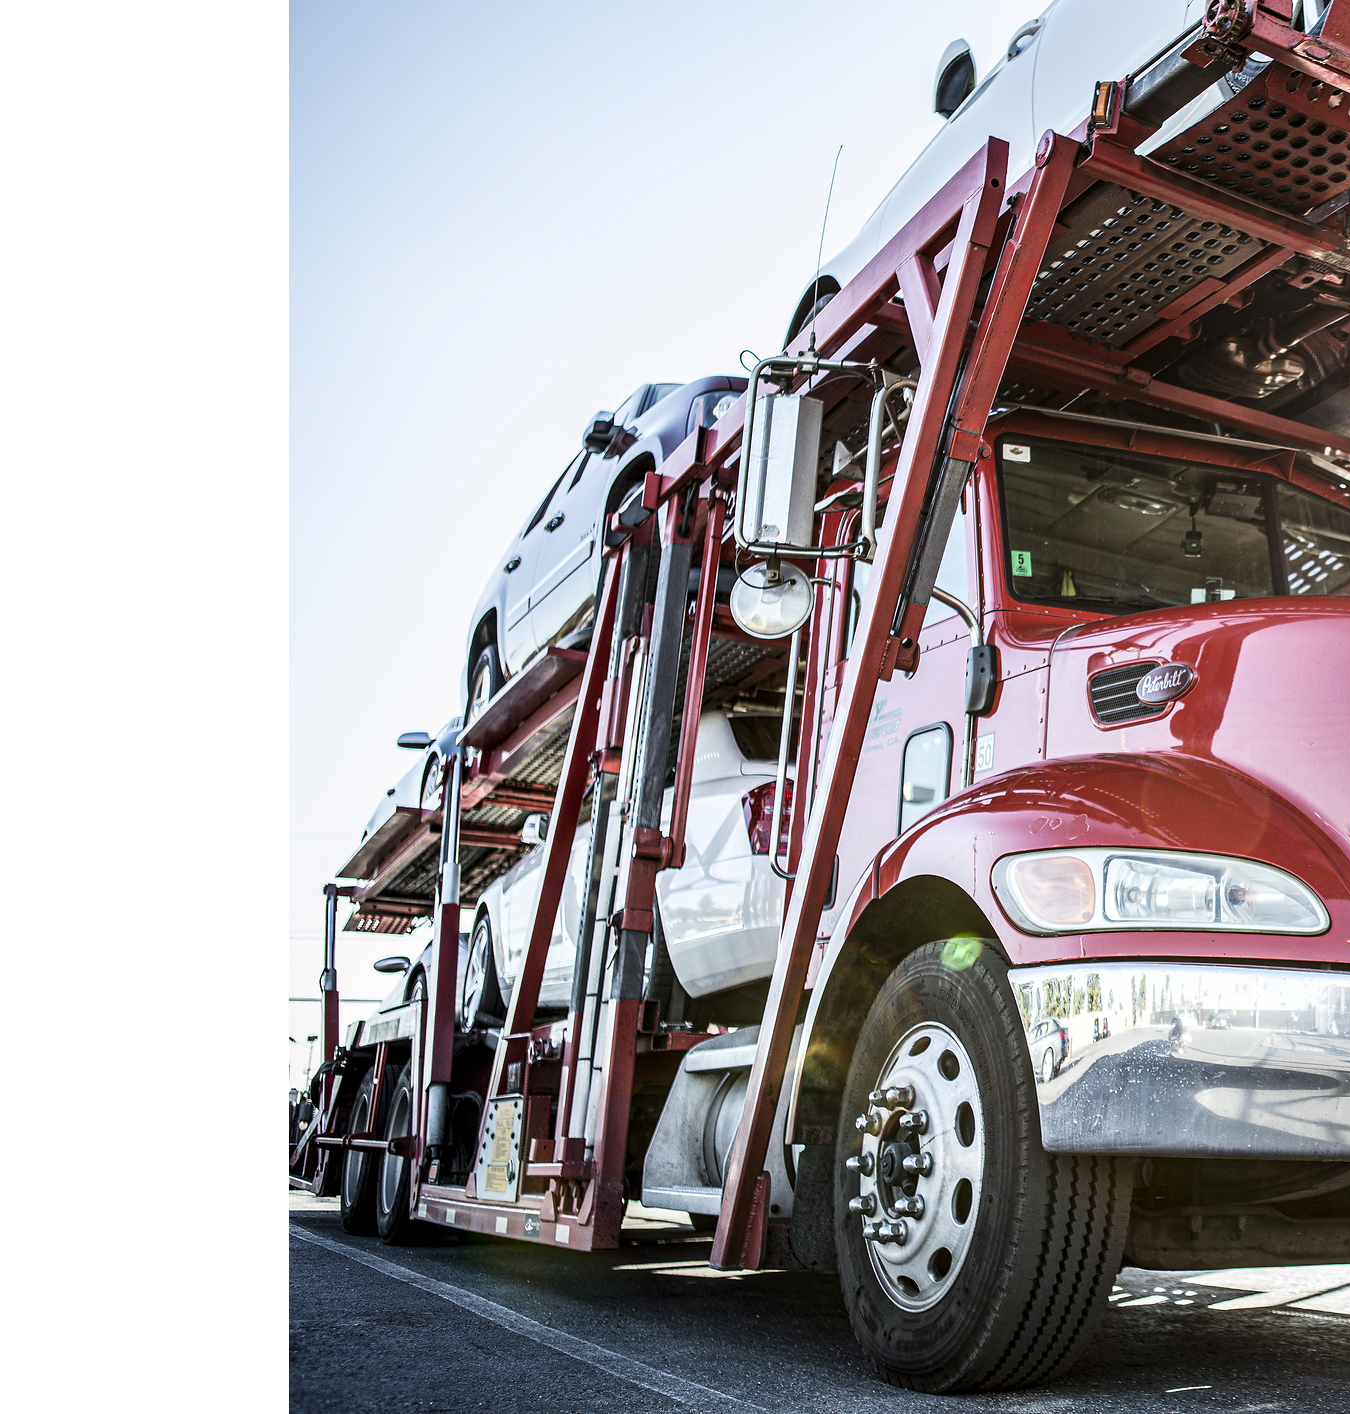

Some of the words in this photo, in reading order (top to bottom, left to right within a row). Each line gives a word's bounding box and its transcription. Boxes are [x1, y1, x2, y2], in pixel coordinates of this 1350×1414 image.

[1018, 553, 1025, 565] 5
[1141, 669, 1187, 697] Peterbilt
[977, 743, 992, 769] 50
